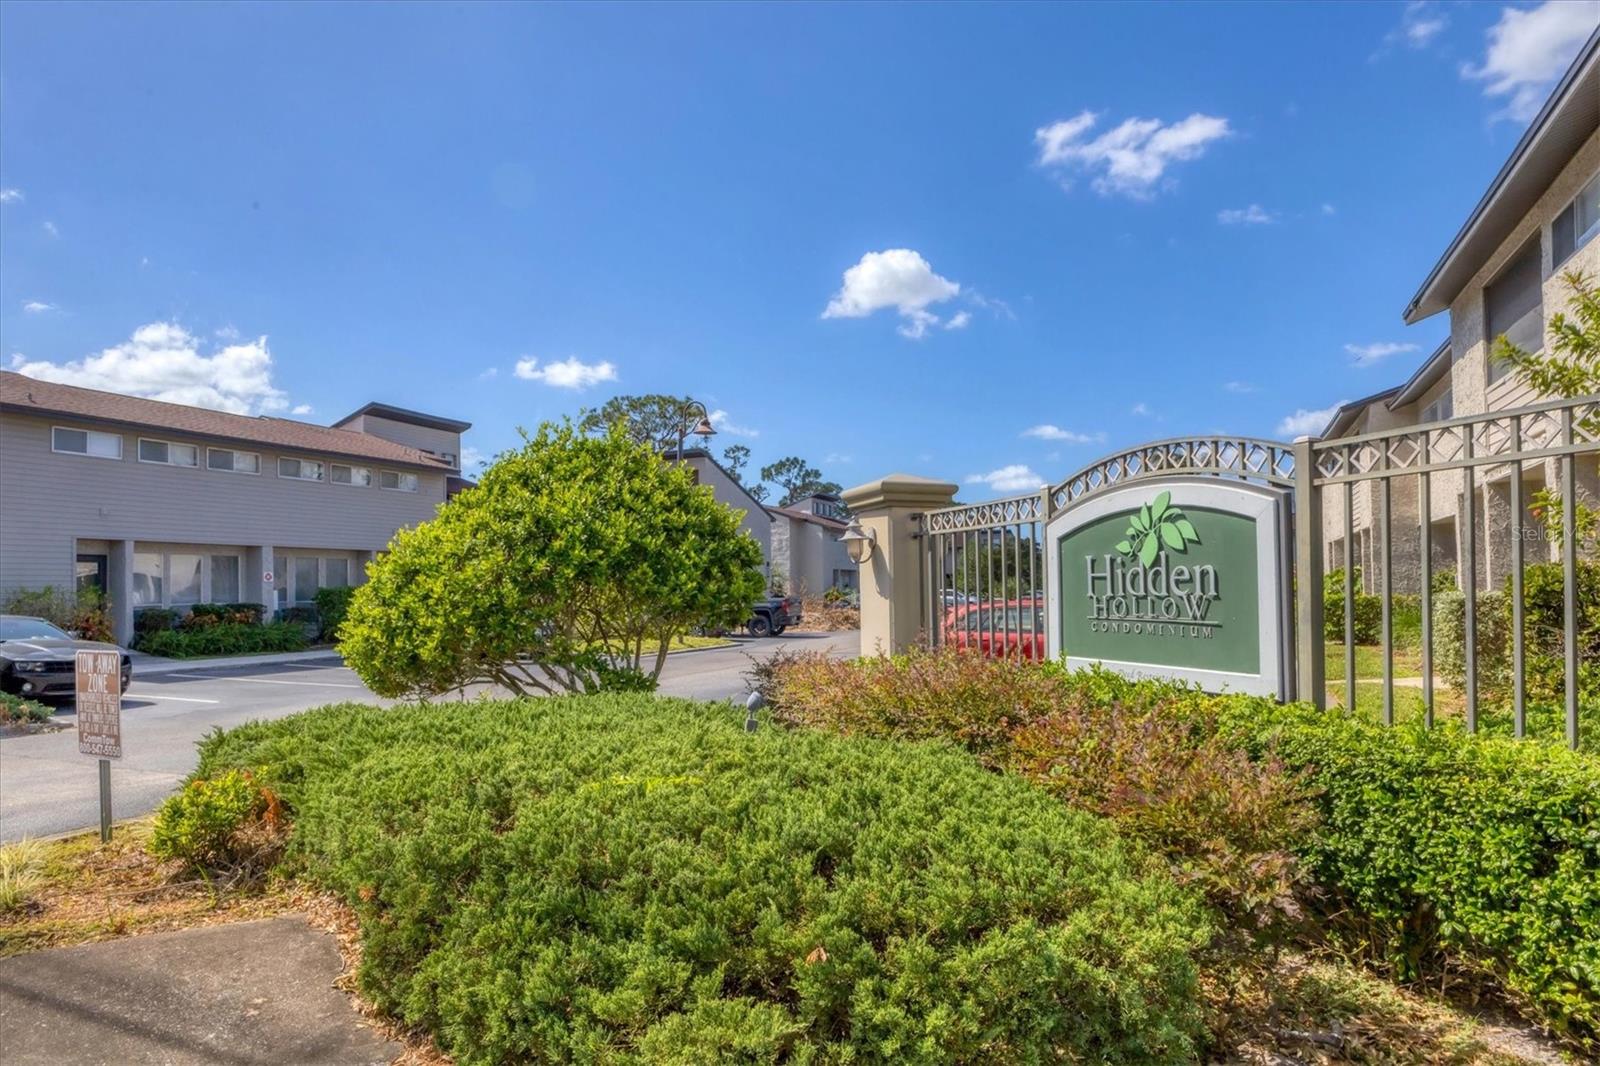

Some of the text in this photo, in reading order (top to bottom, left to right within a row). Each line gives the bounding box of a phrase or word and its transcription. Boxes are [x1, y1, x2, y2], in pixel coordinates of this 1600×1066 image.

[1085, 550, 1218, 597] Hidden
[1092, 593, 1208, 620] HOLLOW
[1091, 621, 1214, 639] CONDOMINIUM
[88, 673, 108, 693] ZONE
